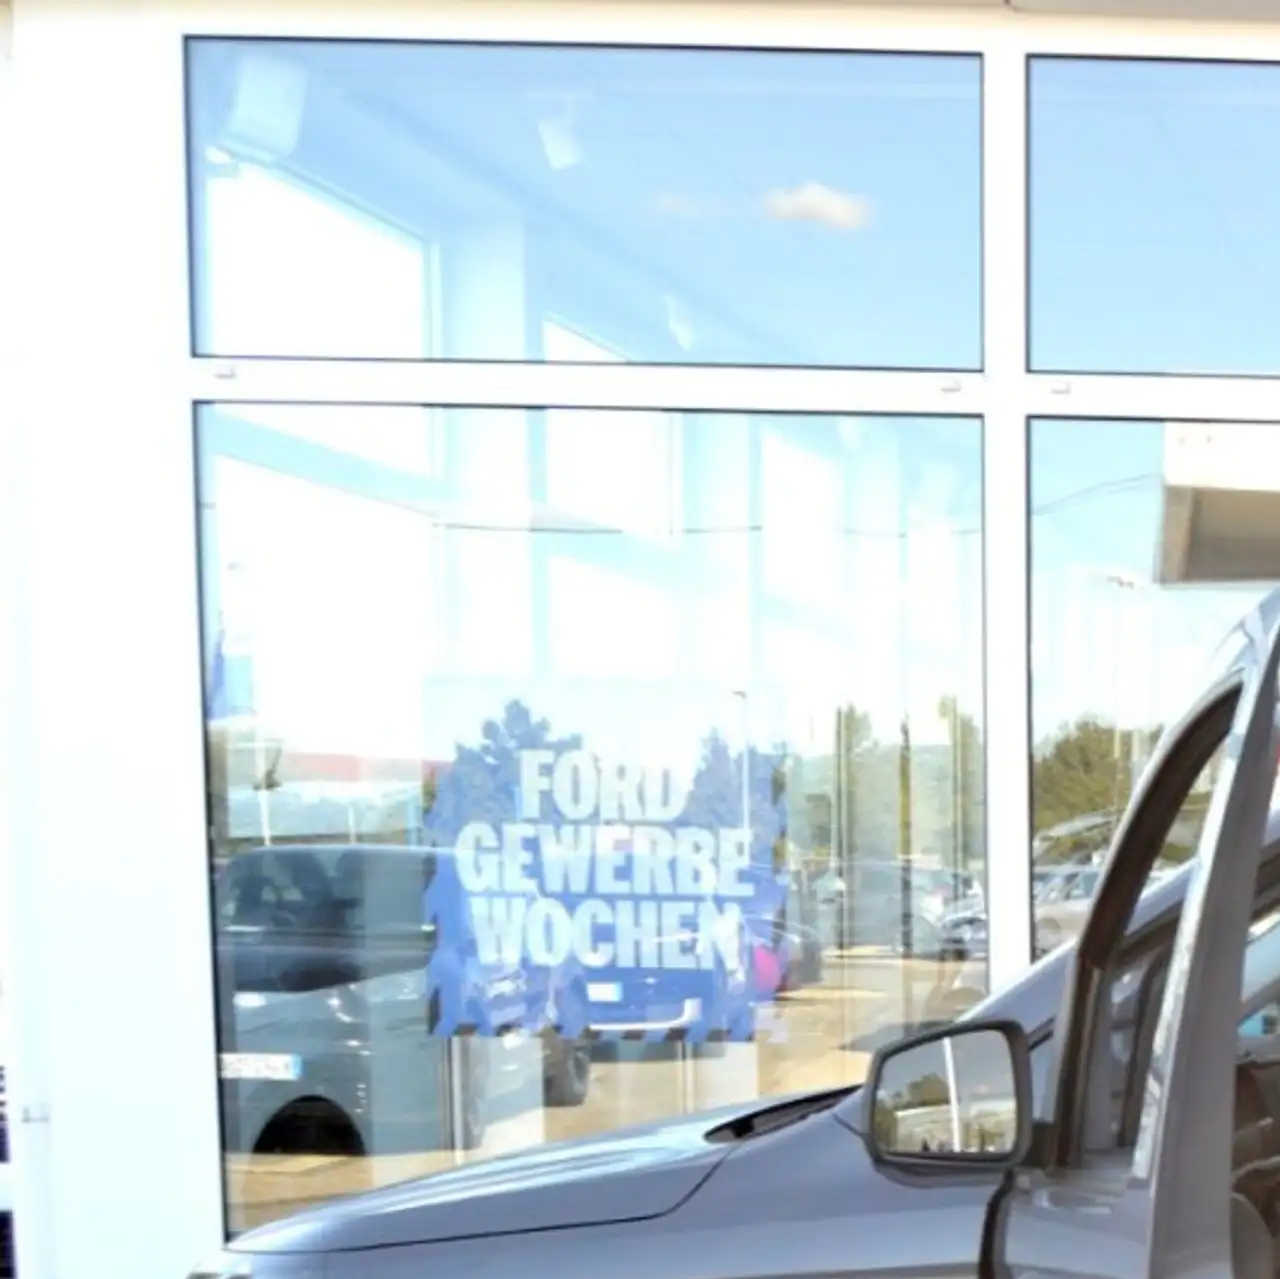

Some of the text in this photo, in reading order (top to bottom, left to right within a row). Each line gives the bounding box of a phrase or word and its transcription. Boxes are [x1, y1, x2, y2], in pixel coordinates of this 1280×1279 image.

[516, 747, 690, 822] FORD
[454, 820, 756, 898] GEWERBE
[468, 893, 742, 971] WOCHEN
